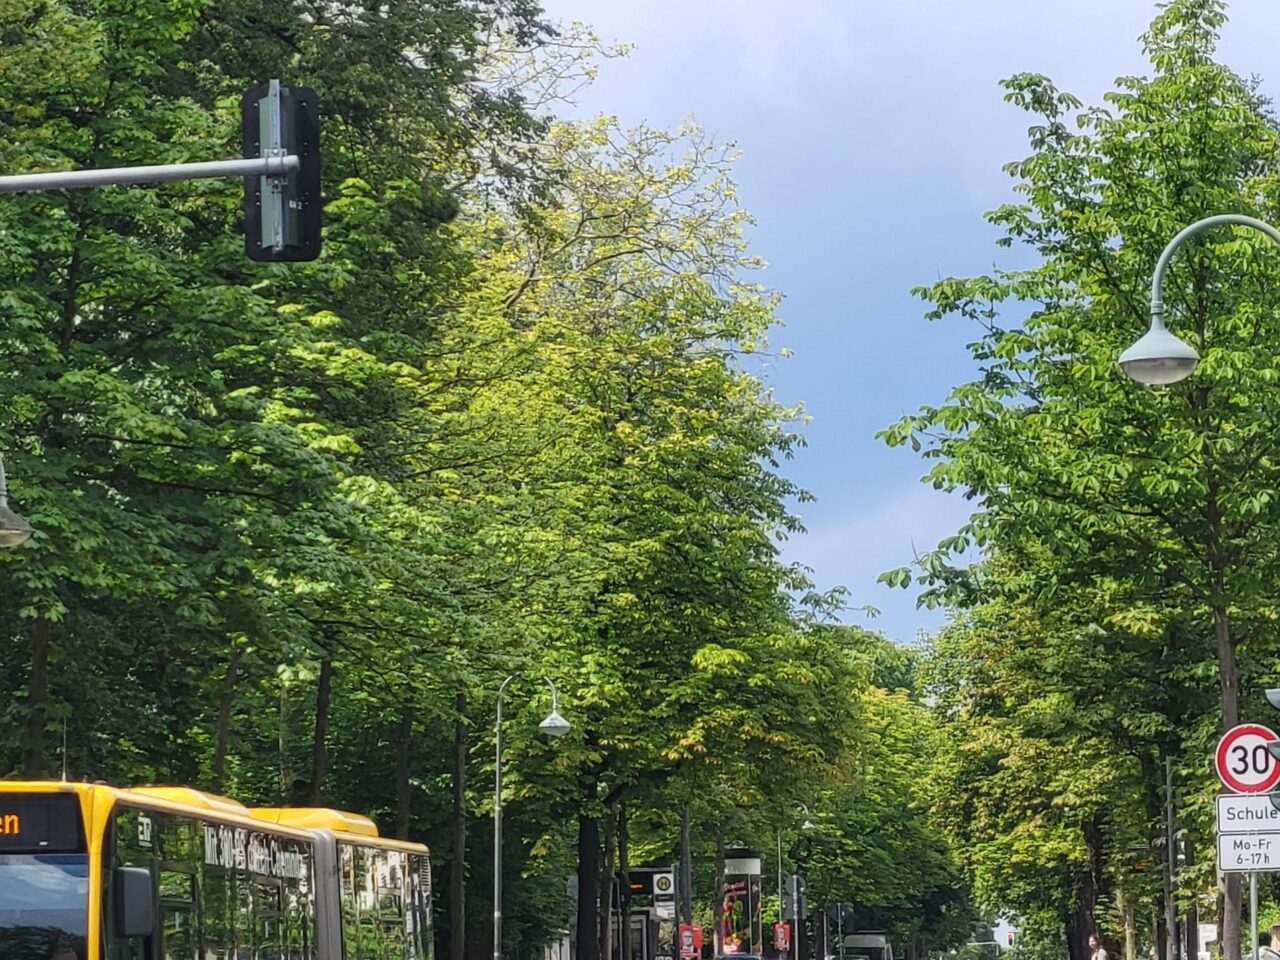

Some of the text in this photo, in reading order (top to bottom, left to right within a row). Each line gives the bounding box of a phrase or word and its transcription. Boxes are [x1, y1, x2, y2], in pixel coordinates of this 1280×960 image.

[1231, 745, 1269, 775] 30
[1226, 806, 1278, 820] Schule
[0, 814, 19, 834] n
[1233, 839, 1272, 850] Mo-Fr
[1236, 853, 1270, 864] 6-17 h
